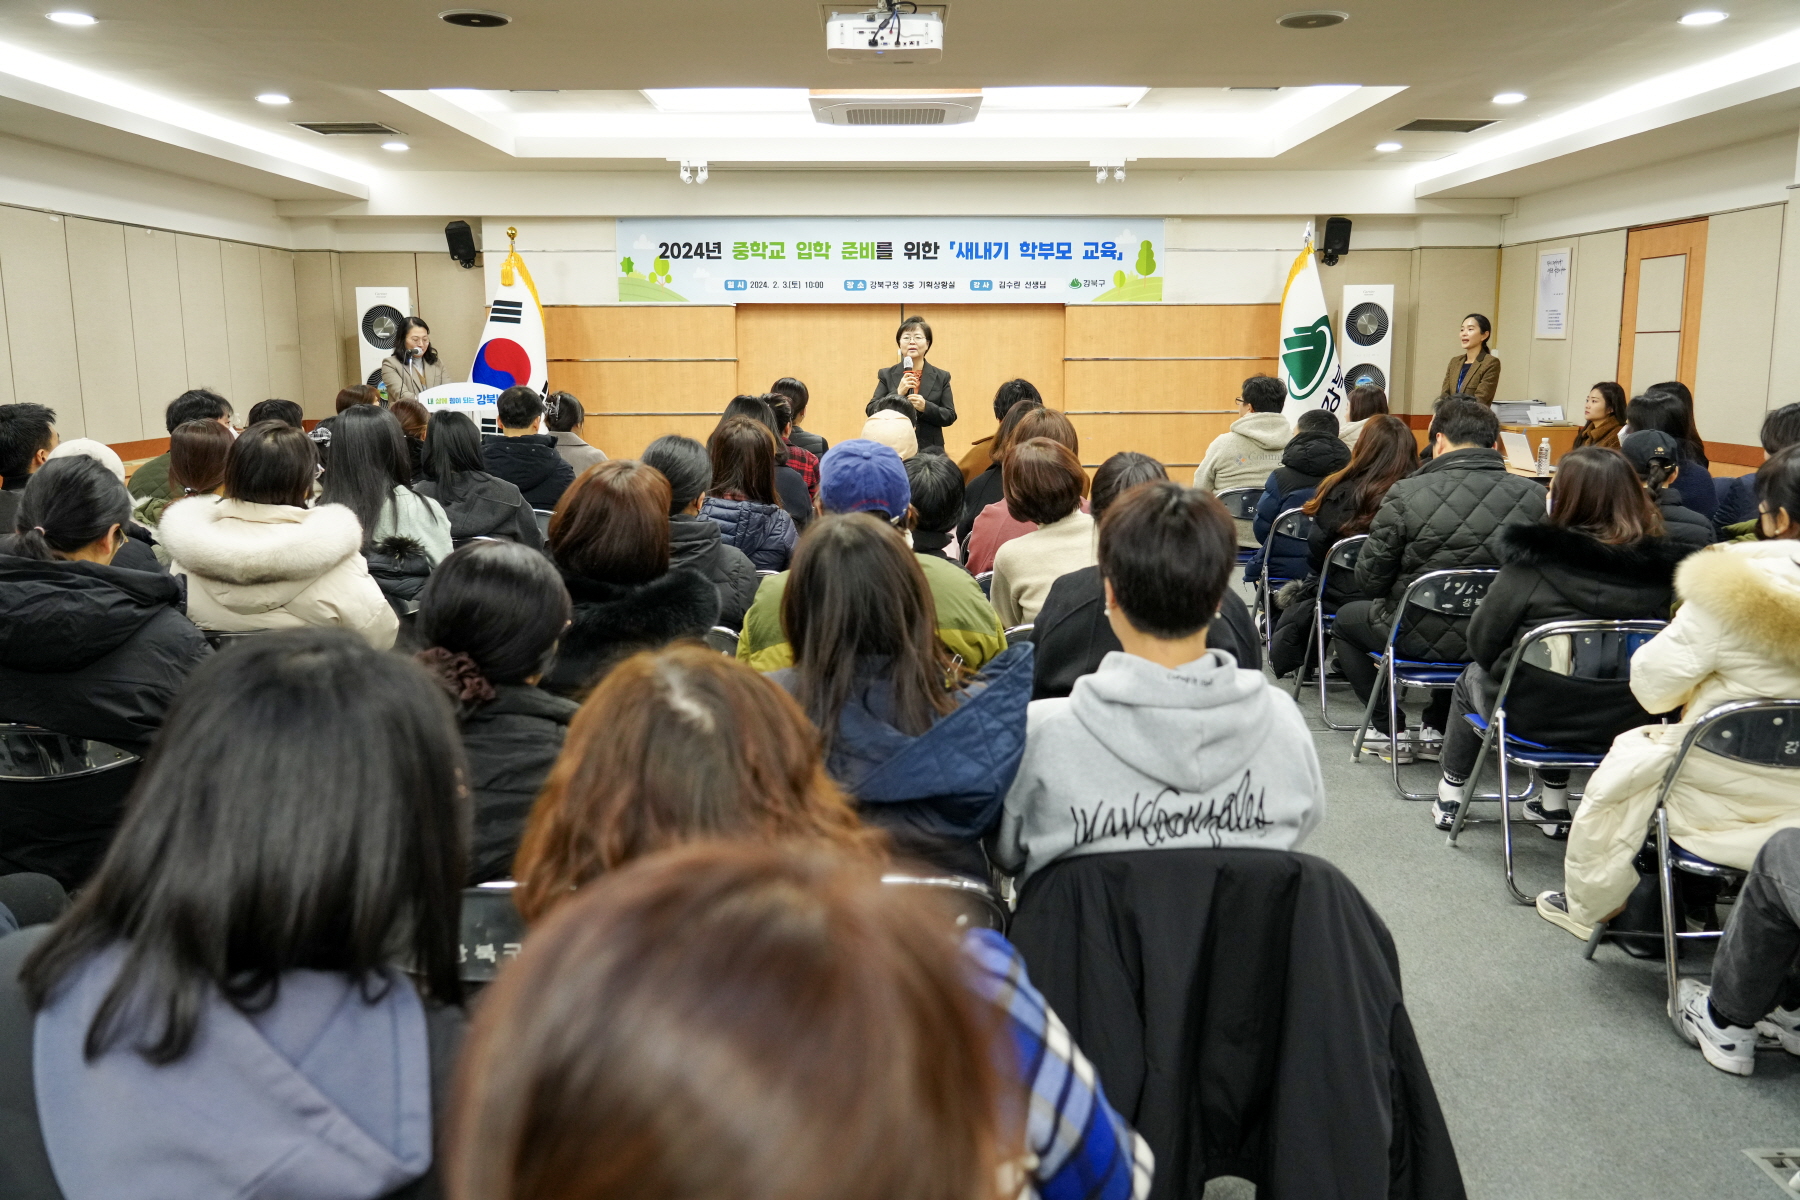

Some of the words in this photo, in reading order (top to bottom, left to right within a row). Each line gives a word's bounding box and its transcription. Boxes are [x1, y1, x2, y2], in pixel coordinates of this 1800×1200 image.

[658, 241, 722, 260] 2024년
[732, 241, 786, 260] 중학교
[796, 241, 831, 260] 입학
[841, 241, 893, 260] 준비를
[904, 241, 940, 260] 위한
[1019, 241, 1073, 260] 학부모
[870, 281, 899, 289] 강북구청
[902, 281, 915, 289] 3층
[919, 281, 956, 289] 기획상황실
[1024, 280, 1047, 289] 선생님
[1083, 279, 1106, 288] 강북구
[427, 397, 434, 405] 내
